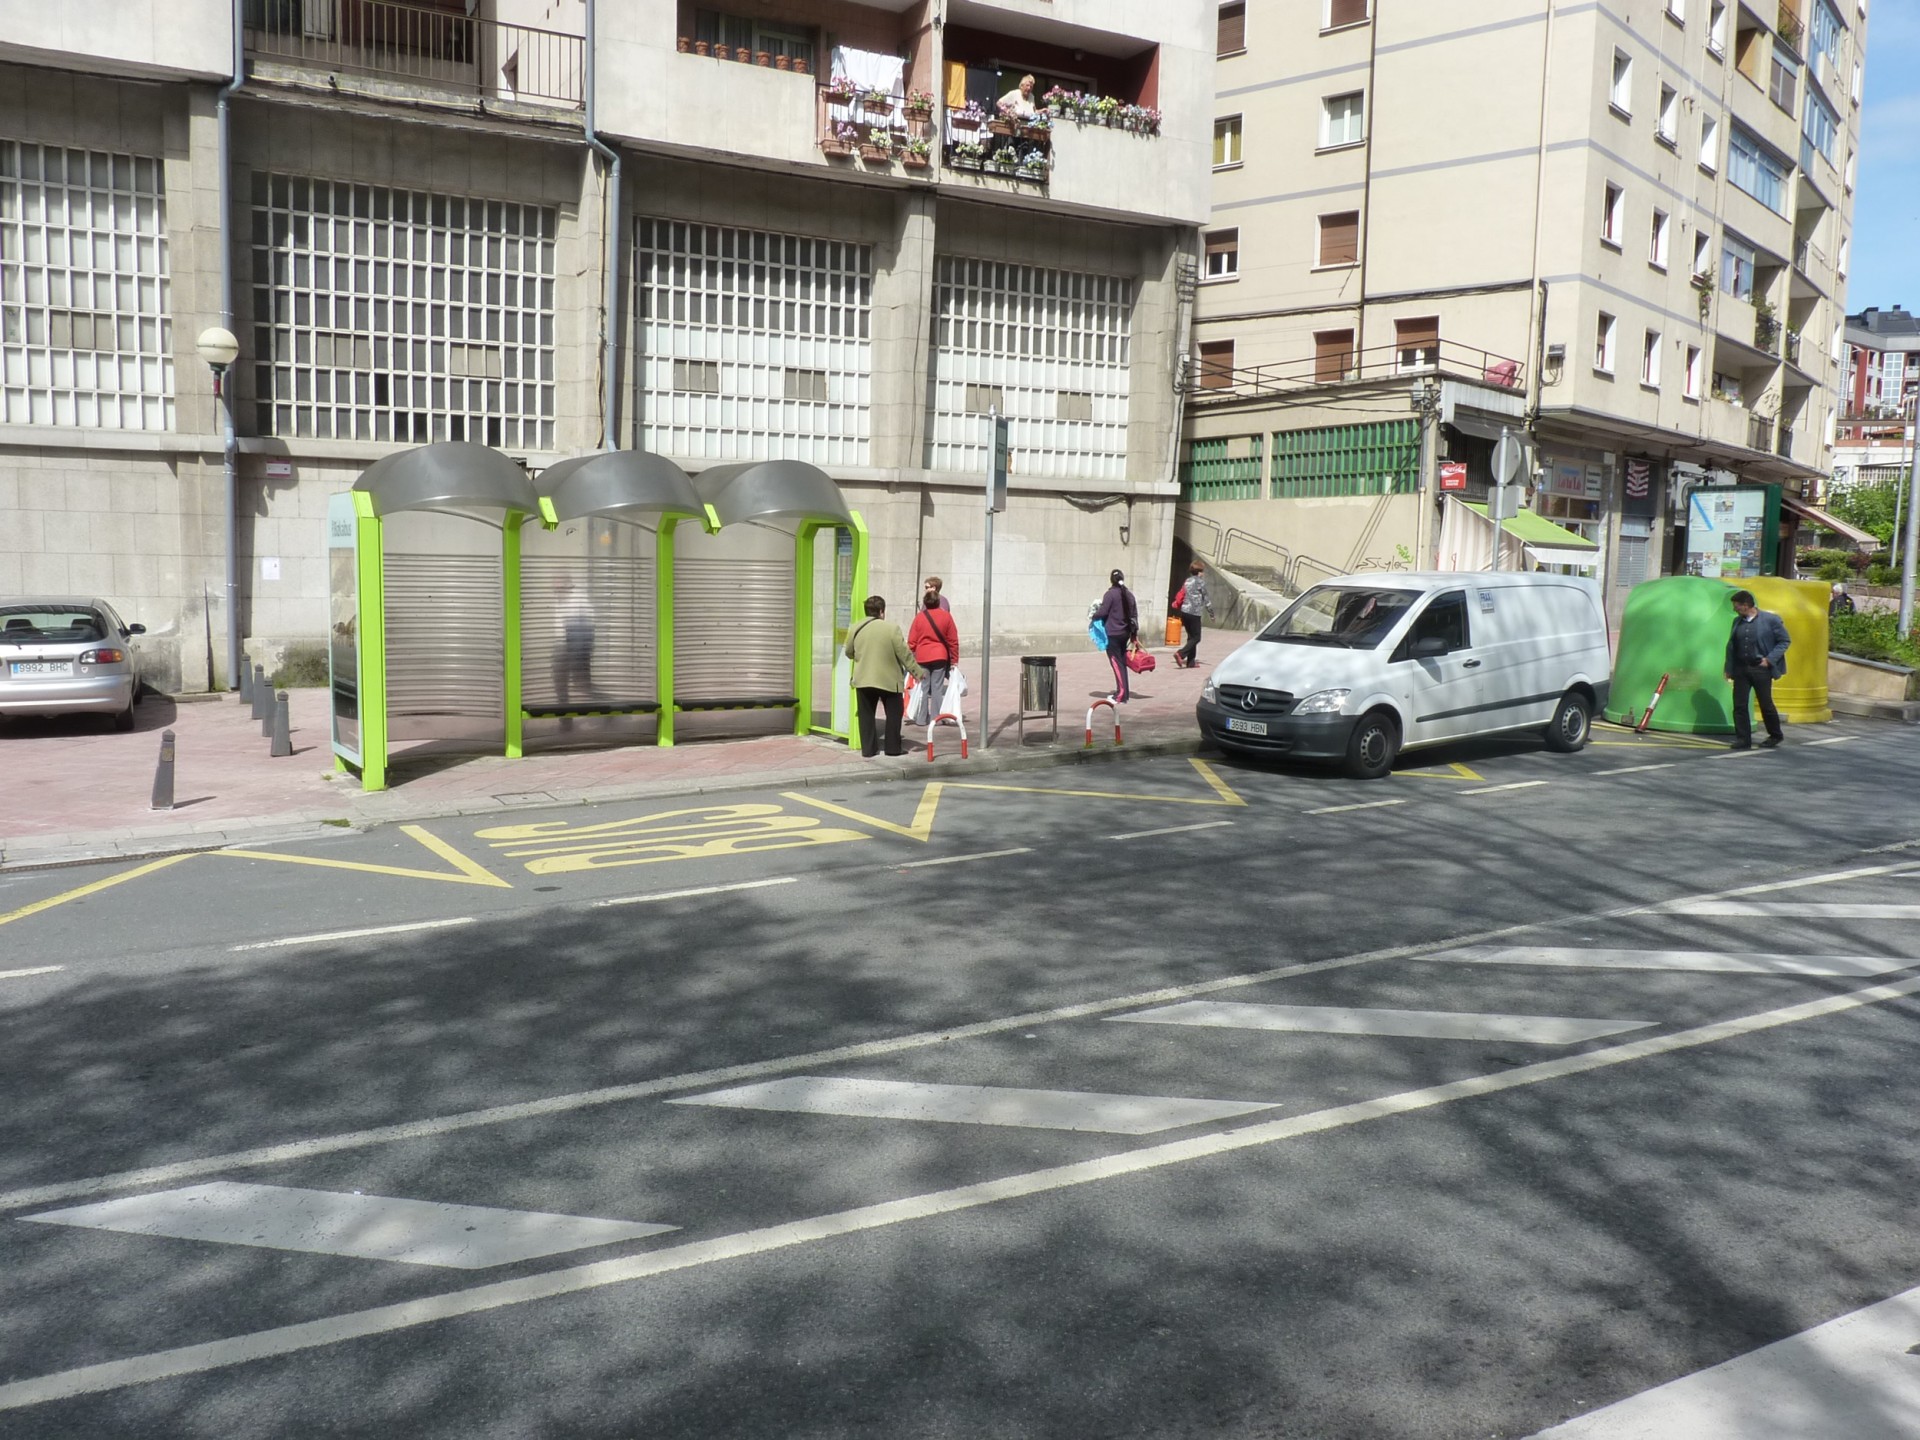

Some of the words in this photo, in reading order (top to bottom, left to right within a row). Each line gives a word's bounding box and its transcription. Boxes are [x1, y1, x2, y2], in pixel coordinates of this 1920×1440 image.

[19, 664, 44, 672] 9992
[49, 663, 68, 672] BHC
[1231, 720, 1248, 731] 3693
[1250, 723, 1265, 733] HBN
